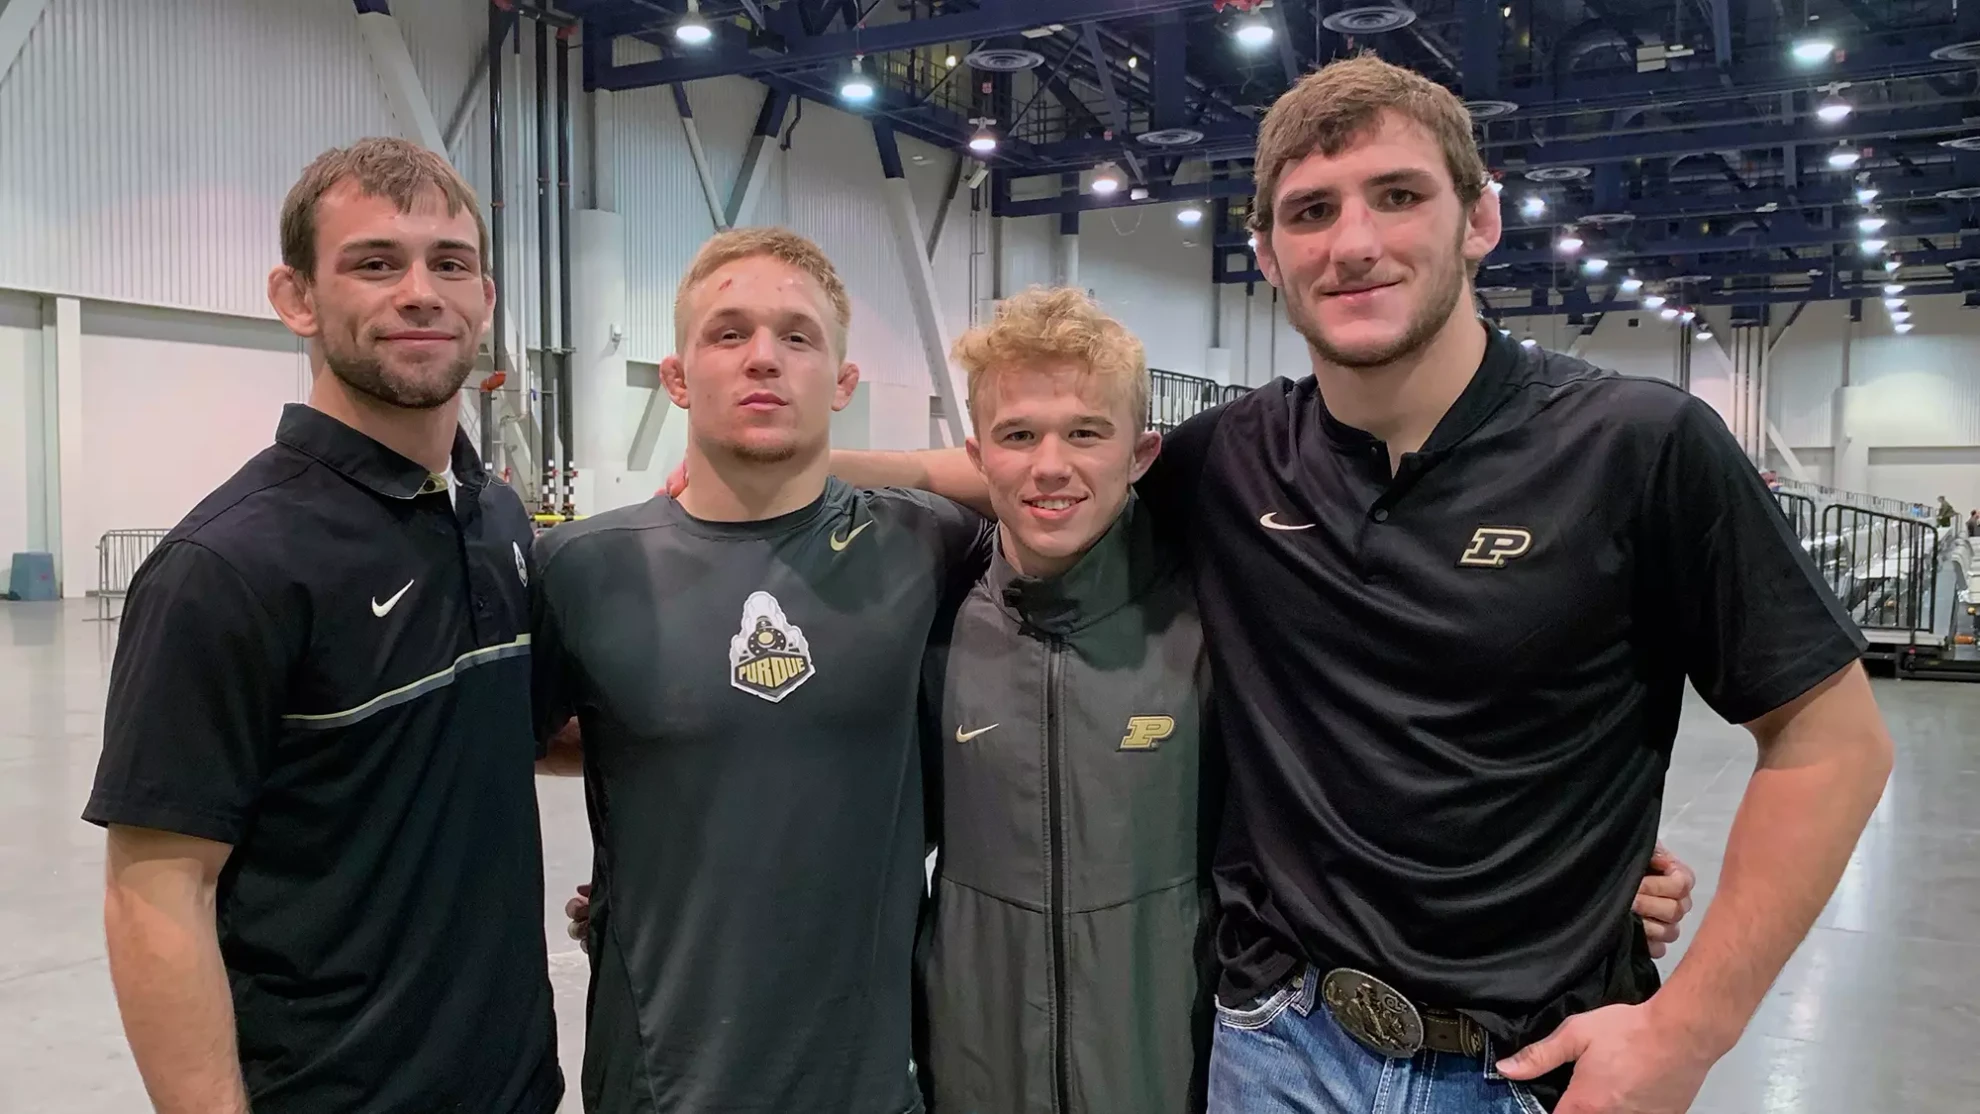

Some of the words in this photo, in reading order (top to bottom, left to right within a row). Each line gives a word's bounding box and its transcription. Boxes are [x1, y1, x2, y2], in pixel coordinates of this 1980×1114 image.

[1460, 528, 1531, 564] P
[738, 656, 806, 688] PURDUE
[1120, 715, 1175, 748] P
